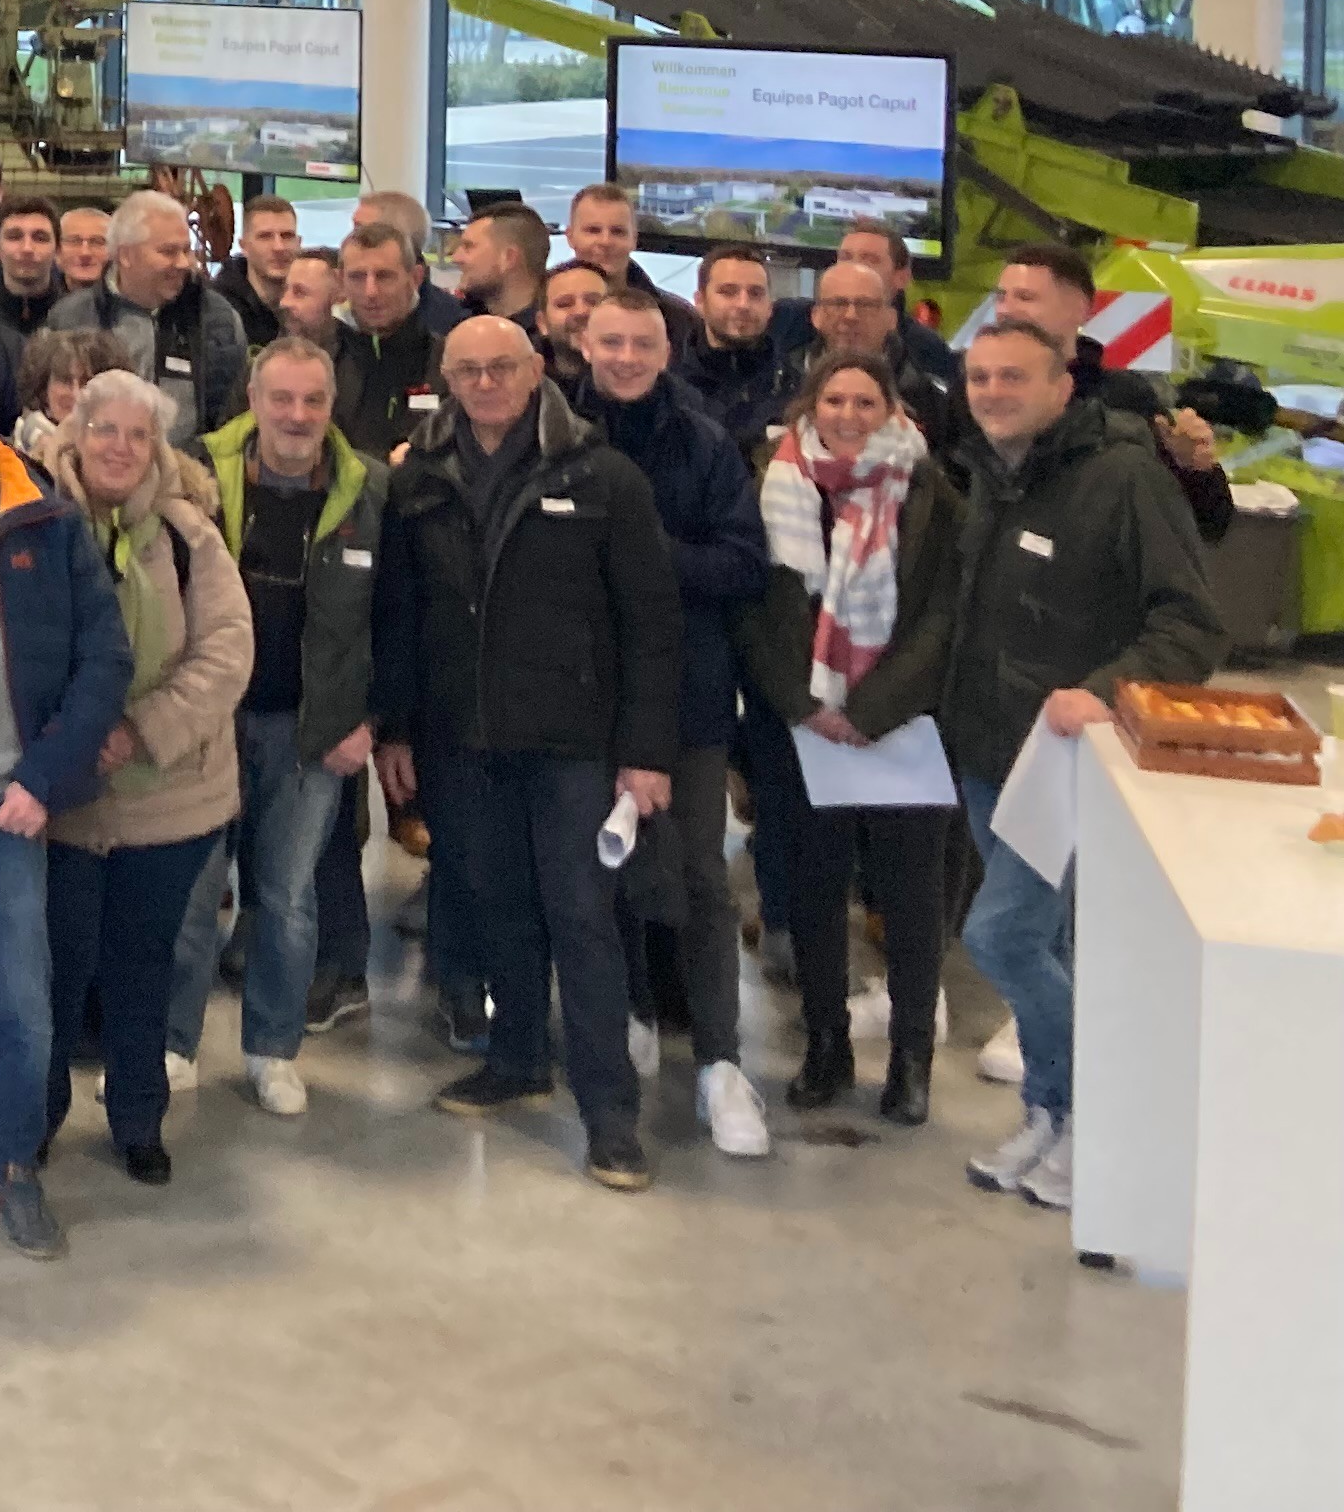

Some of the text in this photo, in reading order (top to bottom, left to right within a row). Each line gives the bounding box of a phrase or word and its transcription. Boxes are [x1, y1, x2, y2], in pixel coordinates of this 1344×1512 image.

[222, 37, 266, 54] Equipes
[269, 40, 302, 55] Pagot
[305, 41, 340, 57] Caput
[652, 60, 737, 78] Willkommen
[752, 88, 917, 113] Equipes Pagot Caput
[1228, 276, 1316, 302] CLAAS
